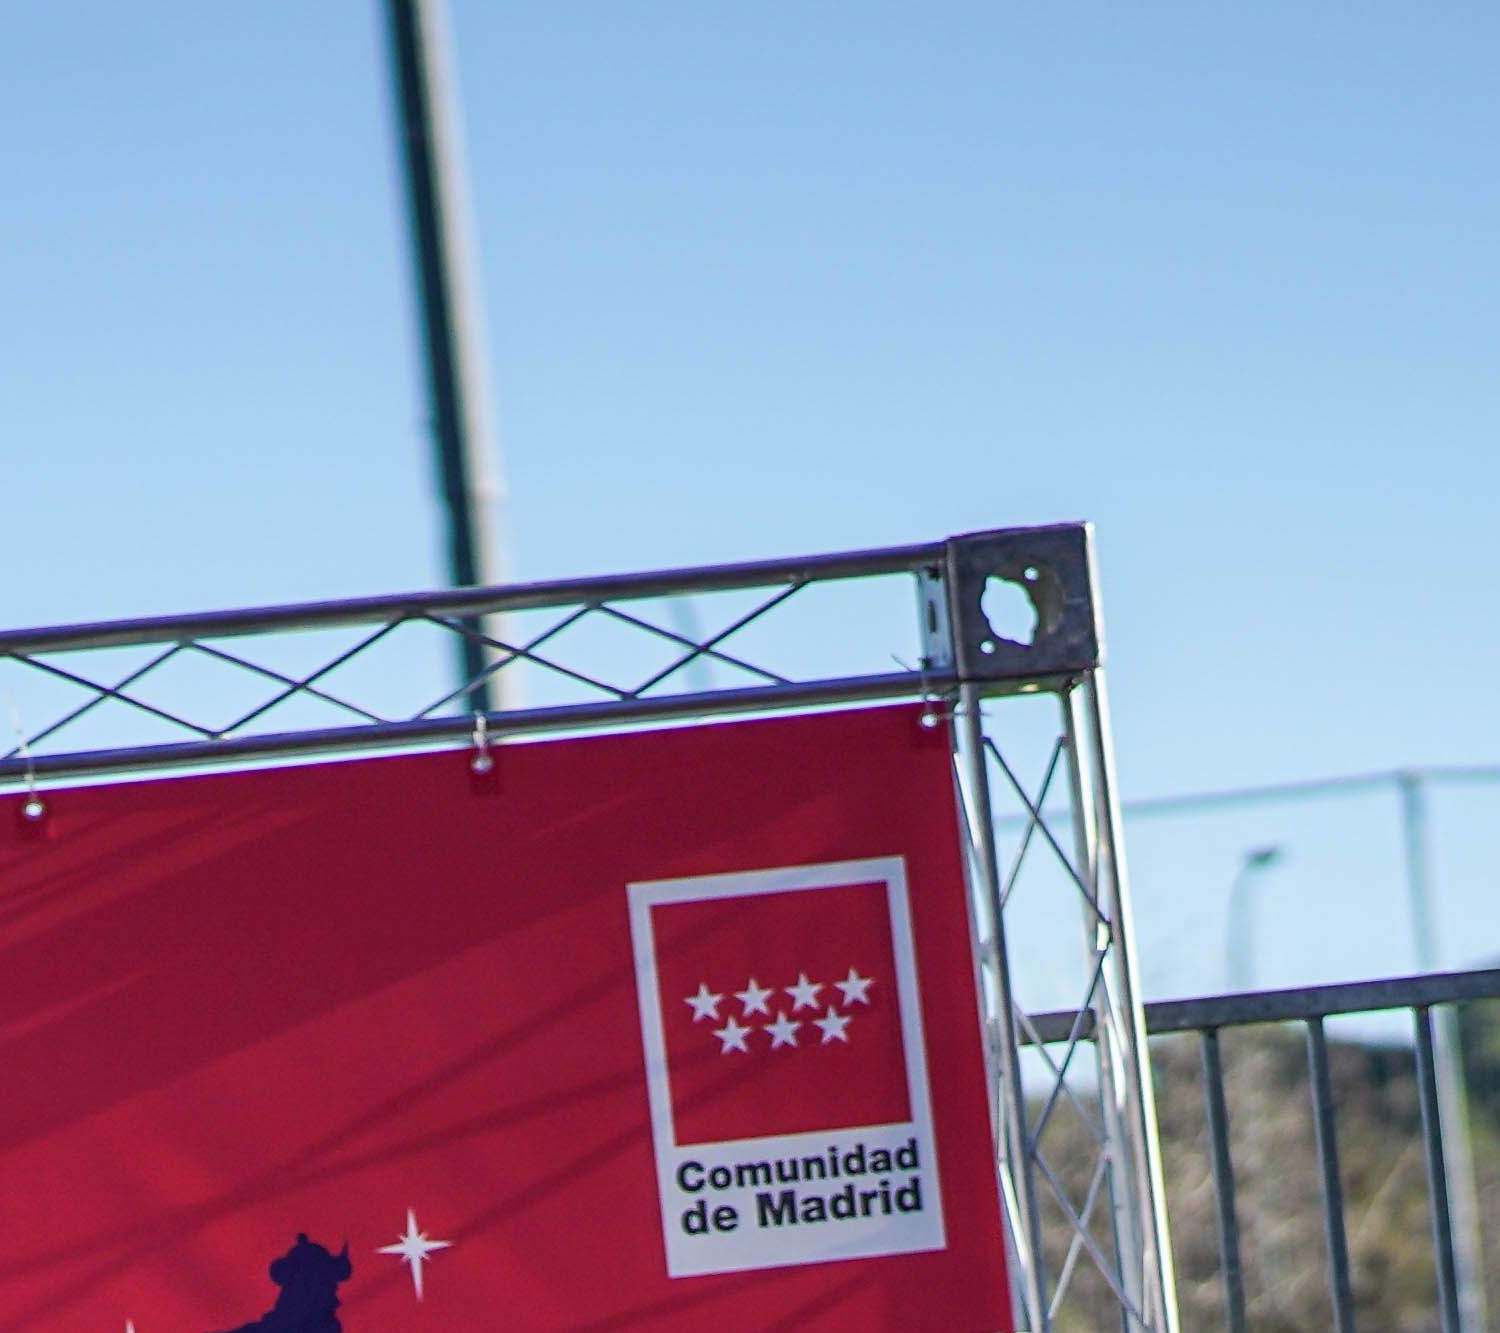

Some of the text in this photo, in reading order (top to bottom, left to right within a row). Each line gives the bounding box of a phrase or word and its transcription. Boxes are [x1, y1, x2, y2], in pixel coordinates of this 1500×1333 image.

[675, 1137, 920, 1194] Comunidad
[681, 1178, 924, 1236] de Madrid
